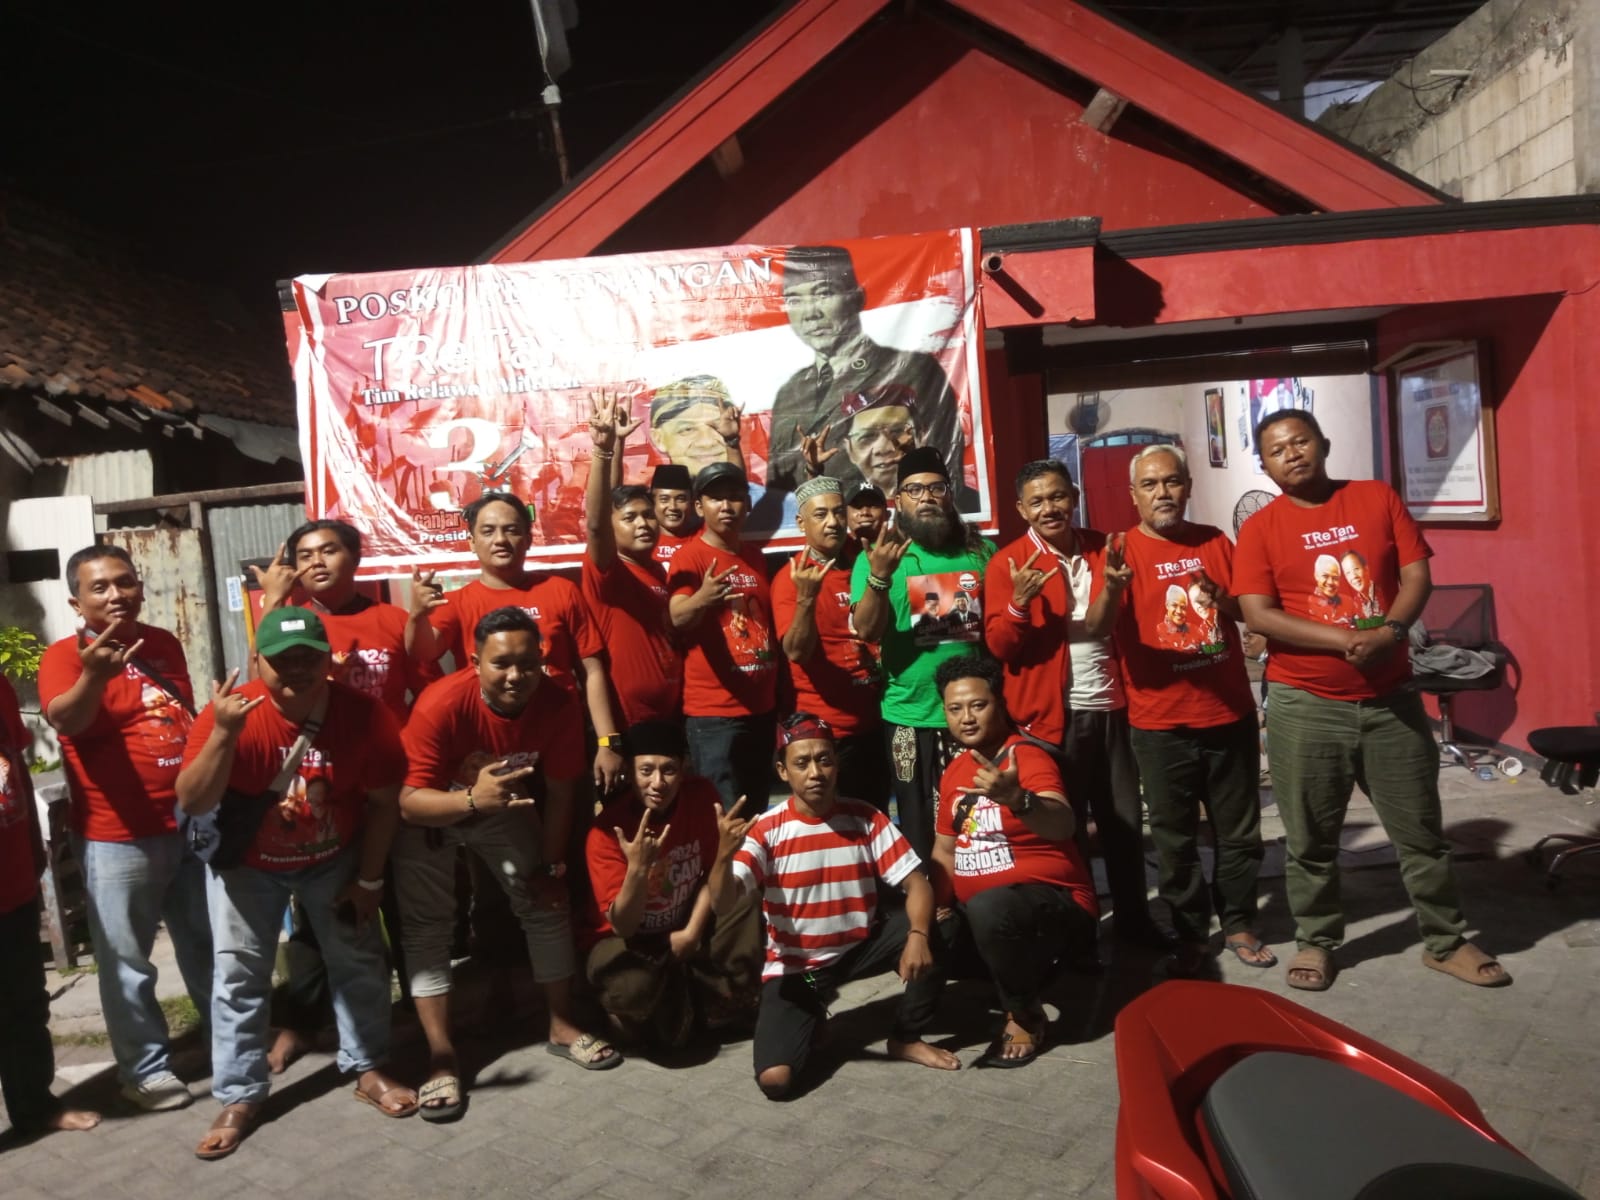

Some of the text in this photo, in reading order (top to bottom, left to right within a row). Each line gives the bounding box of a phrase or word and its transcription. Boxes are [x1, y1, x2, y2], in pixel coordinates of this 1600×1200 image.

[333, 283, 463, 325] POSKO
[362, 326, 560, 381] TReTa
[361, 388, 401, 407] Tim
[405, 378, 491, 402] Relawa
[414, 509, 461, 530] Ganjar
[419, 530, 471, 544] Presid
[1301, 524, 1356, 546] TReTan
[1154, 557, 1202, 576] TReTan
[157, 755, 183, 768] Presi
